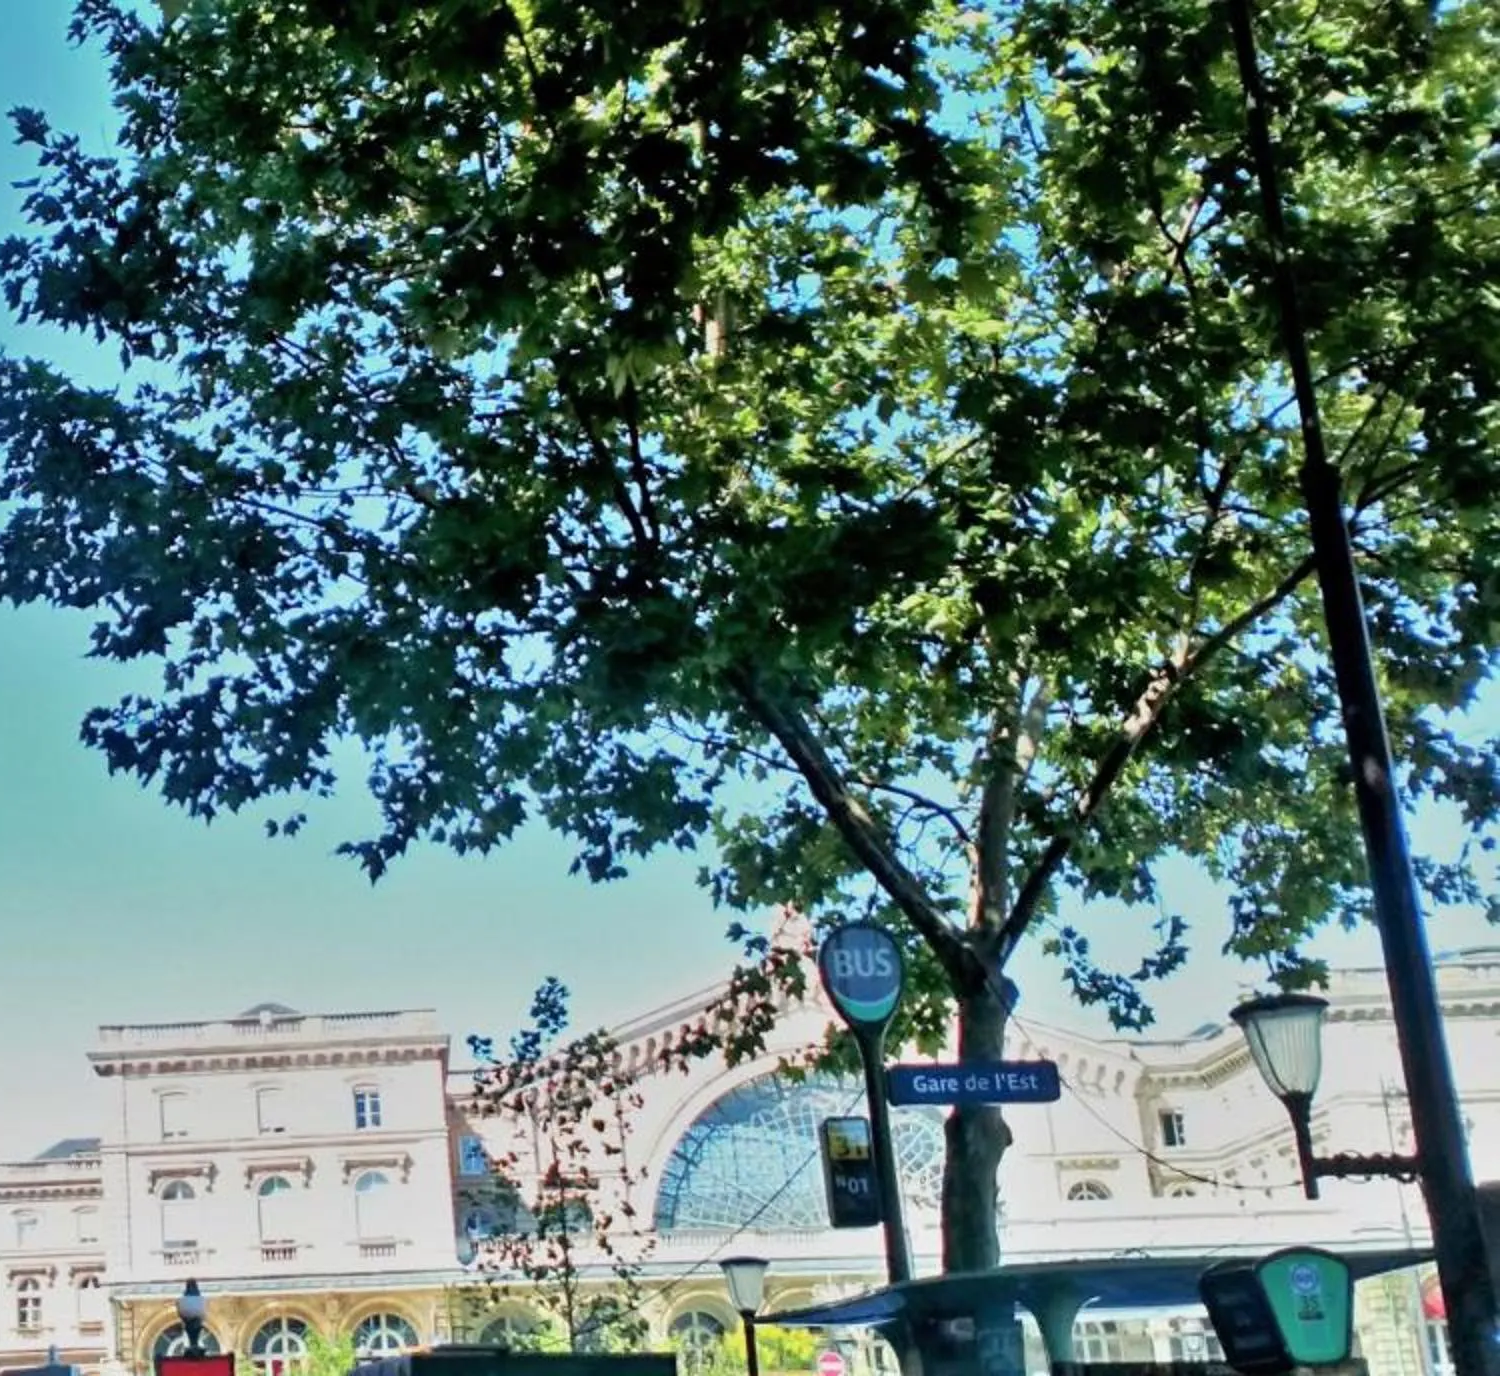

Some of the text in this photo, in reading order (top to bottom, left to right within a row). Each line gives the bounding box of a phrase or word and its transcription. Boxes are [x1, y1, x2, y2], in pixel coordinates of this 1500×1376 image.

[833, 947, 891, 977] BUS
[913, 1073, 1038, 1093] Gare de l'Est
